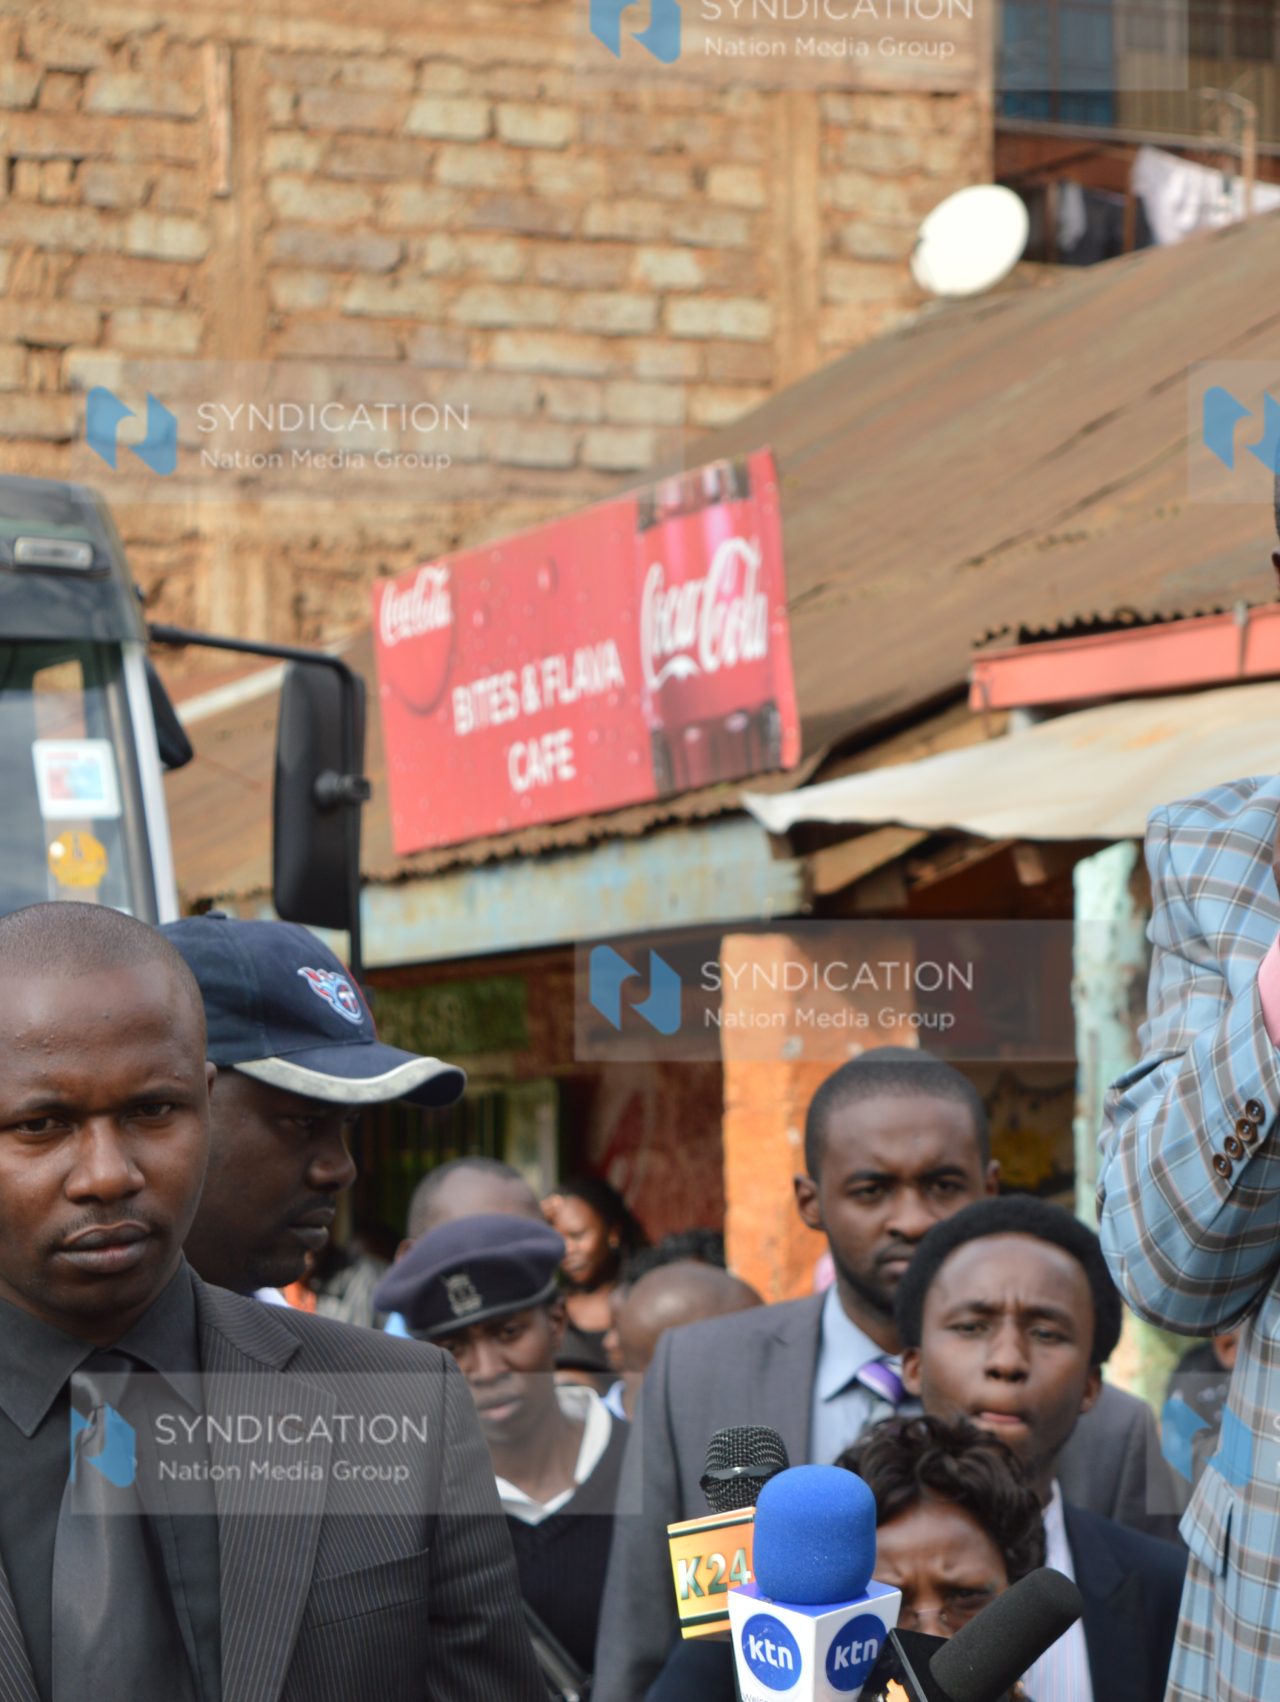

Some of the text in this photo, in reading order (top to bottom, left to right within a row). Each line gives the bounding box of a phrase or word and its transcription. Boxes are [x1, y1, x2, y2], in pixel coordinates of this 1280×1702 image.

[452, 638, 626, 736] BITES & FLAVA
[507, 727, 577, 794] CAFE
[677, 1547, 752, 1600] K24
[748, 1634, 794, 1671] ktn
[834, 1637, 879, 1671] ktn
